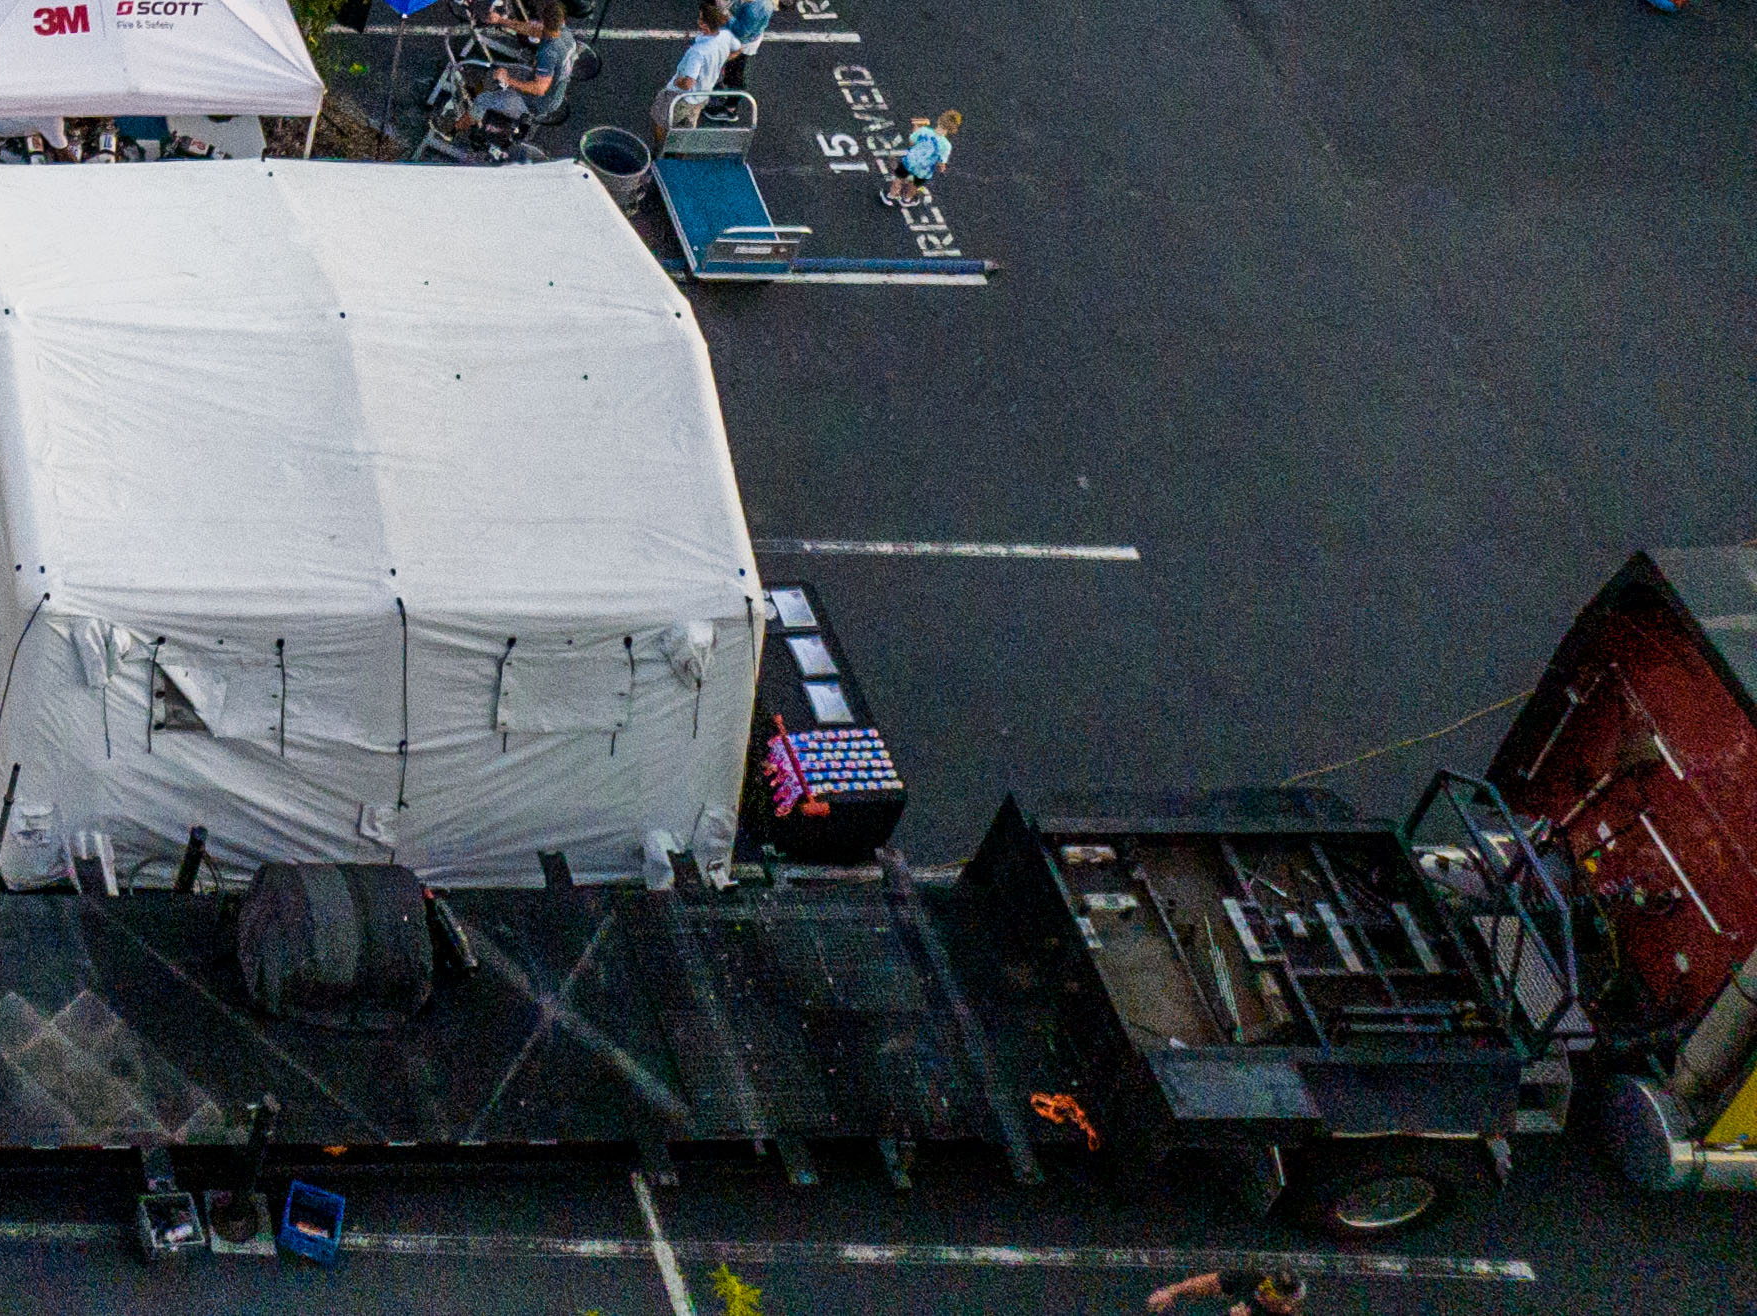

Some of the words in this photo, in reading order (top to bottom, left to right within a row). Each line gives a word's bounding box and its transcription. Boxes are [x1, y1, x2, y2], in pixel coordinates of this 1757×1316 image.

[33, 3, 91, 37] 3M
[136, 1, 205, 17] SCOTT
[116, 20, 138, 31] Fire
[151, 20, 175, 32] Safety
[816, 131, 871, 174] 15
